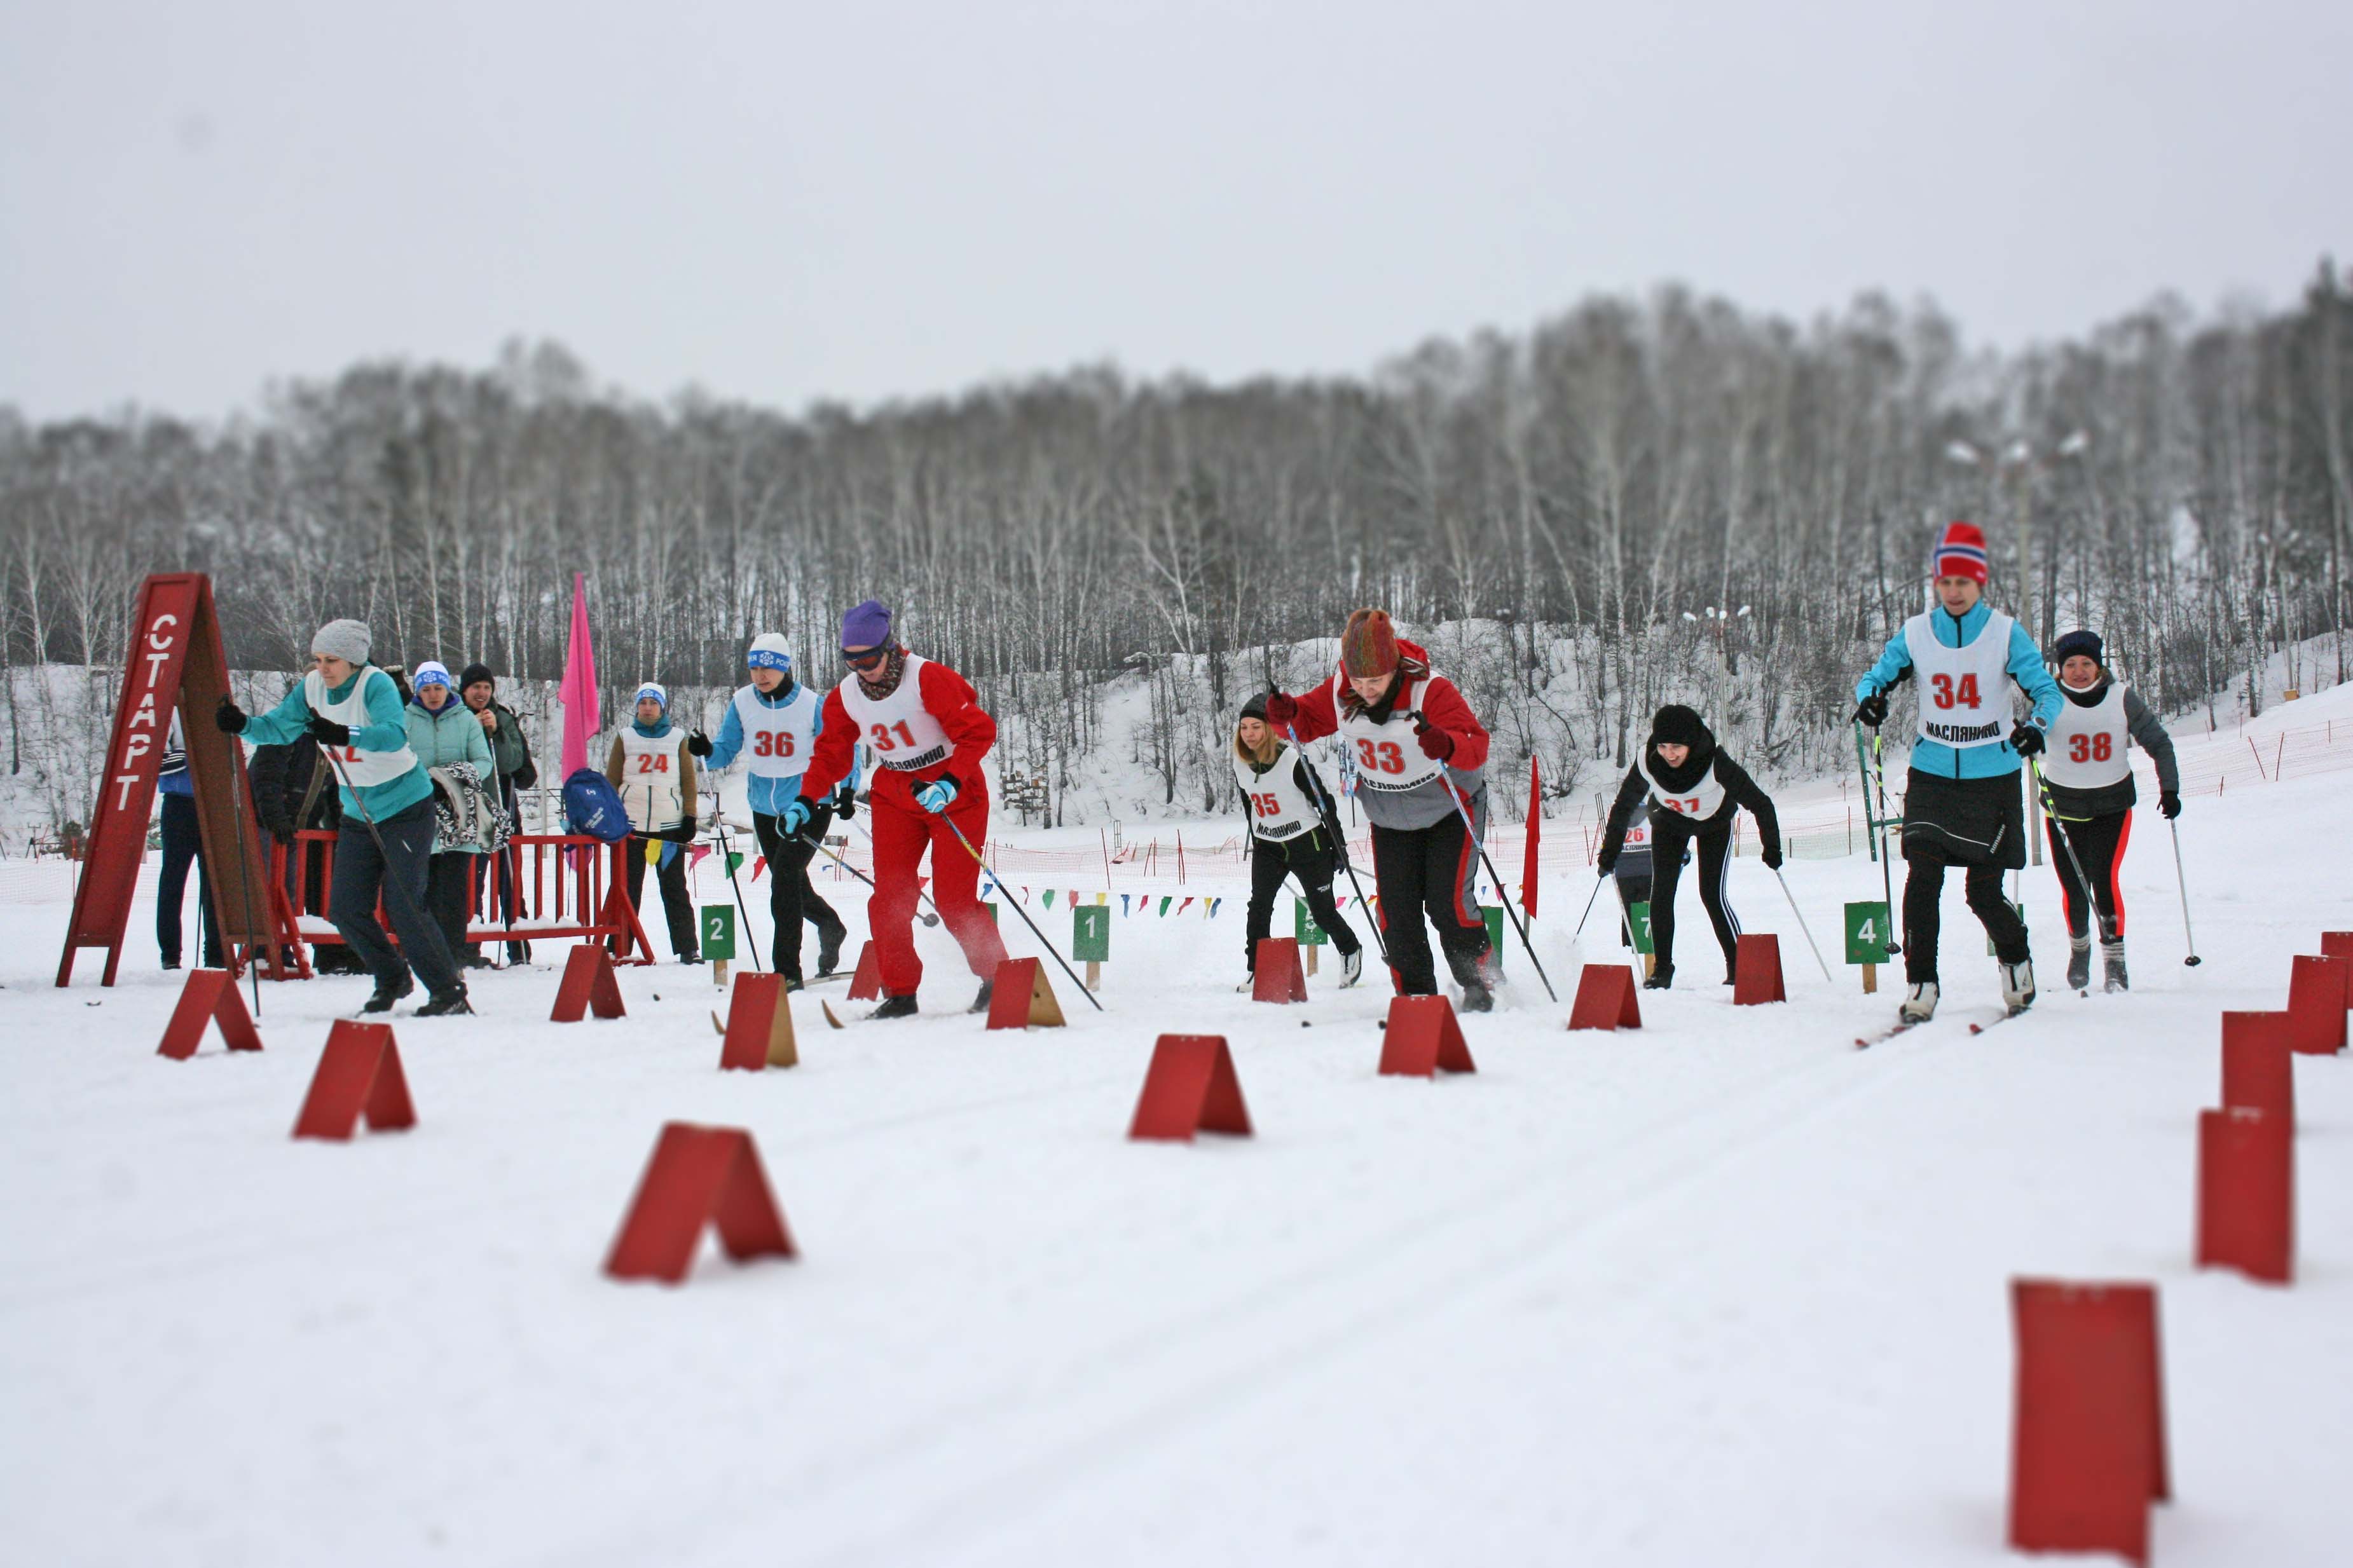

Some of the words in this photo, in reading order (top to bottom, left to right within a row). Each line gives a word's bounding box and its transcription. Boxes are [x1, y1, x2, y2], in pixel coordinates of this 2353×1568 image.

[1931, 672, 1982, 710] 34
[116, 614, 177, 811] СТАРТ
[870, 719, 917, 751] 31
[1926, 720, 2000, 742] МАСЛЯНИНО
[754, 730, 794, 758] 36
[1356, 738, 1406, 775] 33
[2069, 732, 2112, 763] 38
[638, 754, 668, 774] 24
[1251, 793, 1280, 818] 35
[1624, 828, 1644, 843] 26
[710, 918, 724, 940] 2
[1085, 915, 1095, 938] 1
[1640, 917, 1651, 938] 7
[1858, 918, 1876, 944] 4
